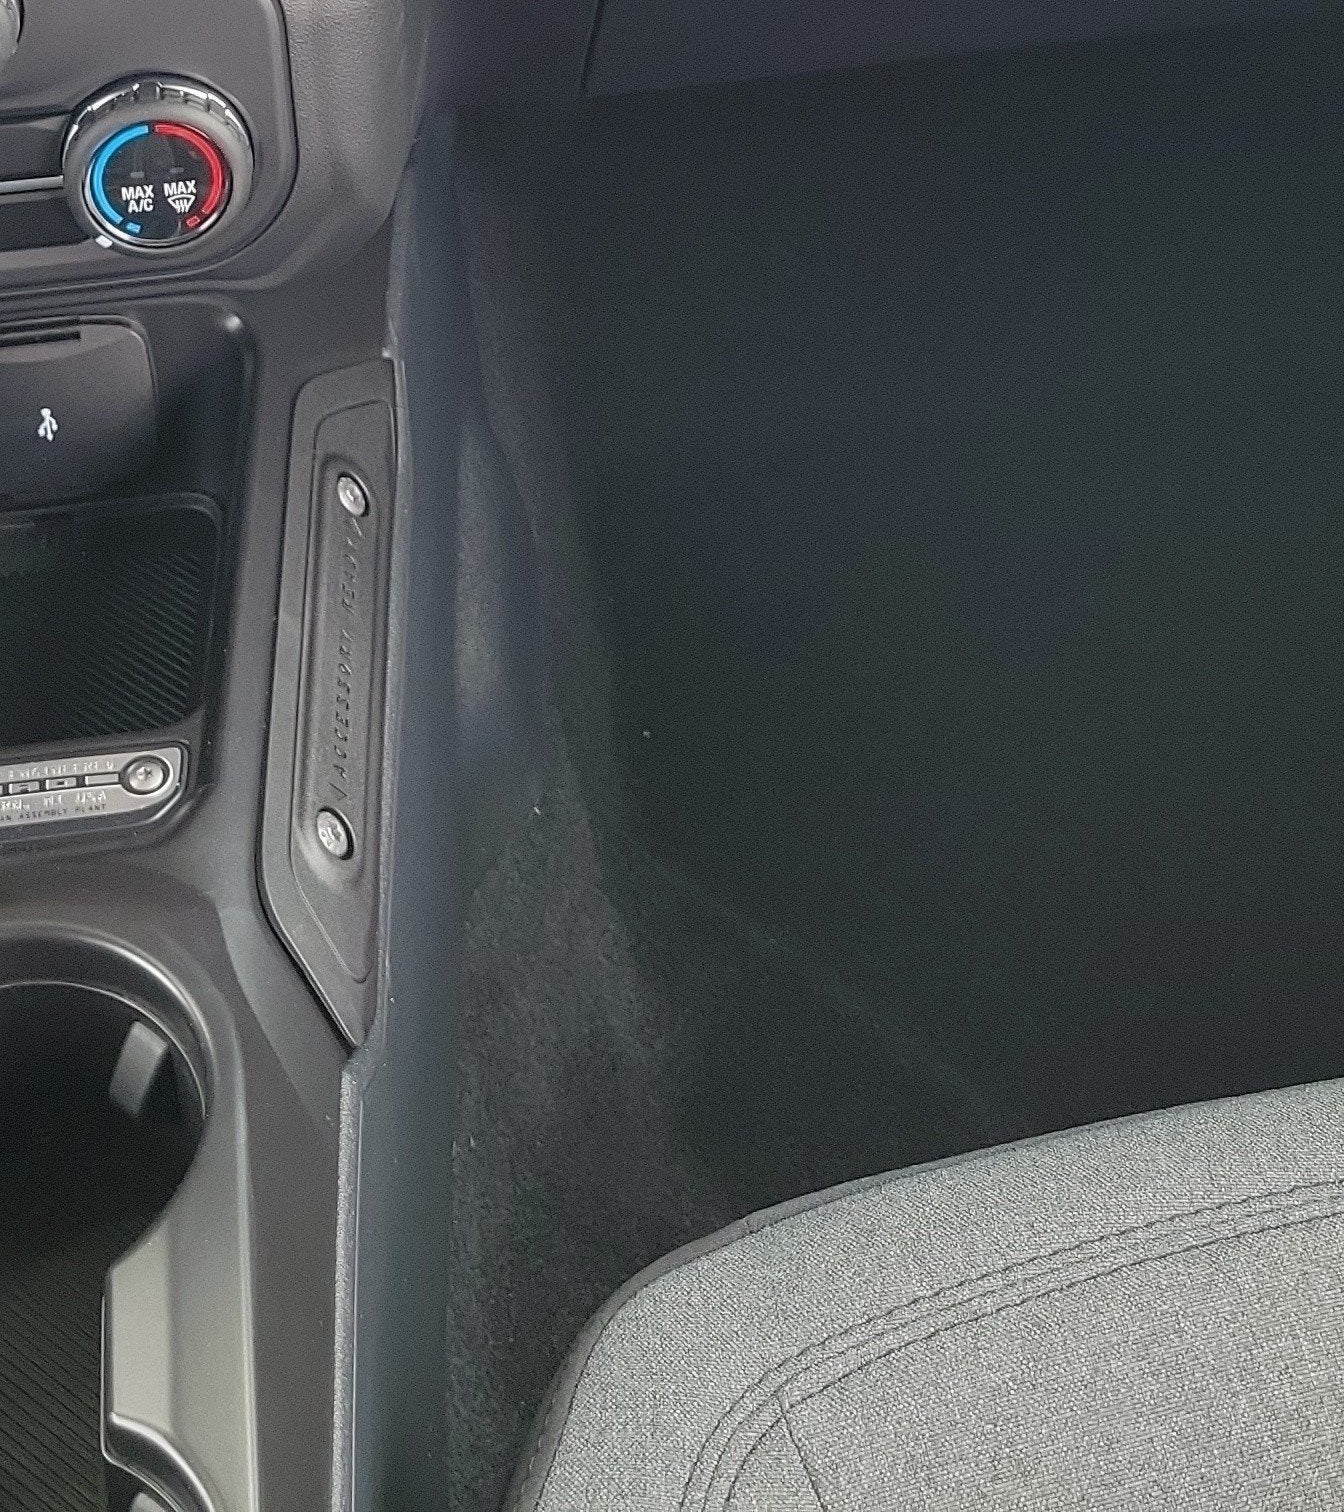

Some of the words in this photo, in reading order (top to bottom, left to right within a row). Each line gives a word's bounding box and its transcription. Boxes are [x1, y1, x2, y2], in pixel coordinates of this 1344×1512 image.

[120, 184, 155, 202] MAX
[163, 179, 197, 197] MAX
[127, 197, 154, 214] A/C
[331, 629, 353, 780] ACCESSORY
